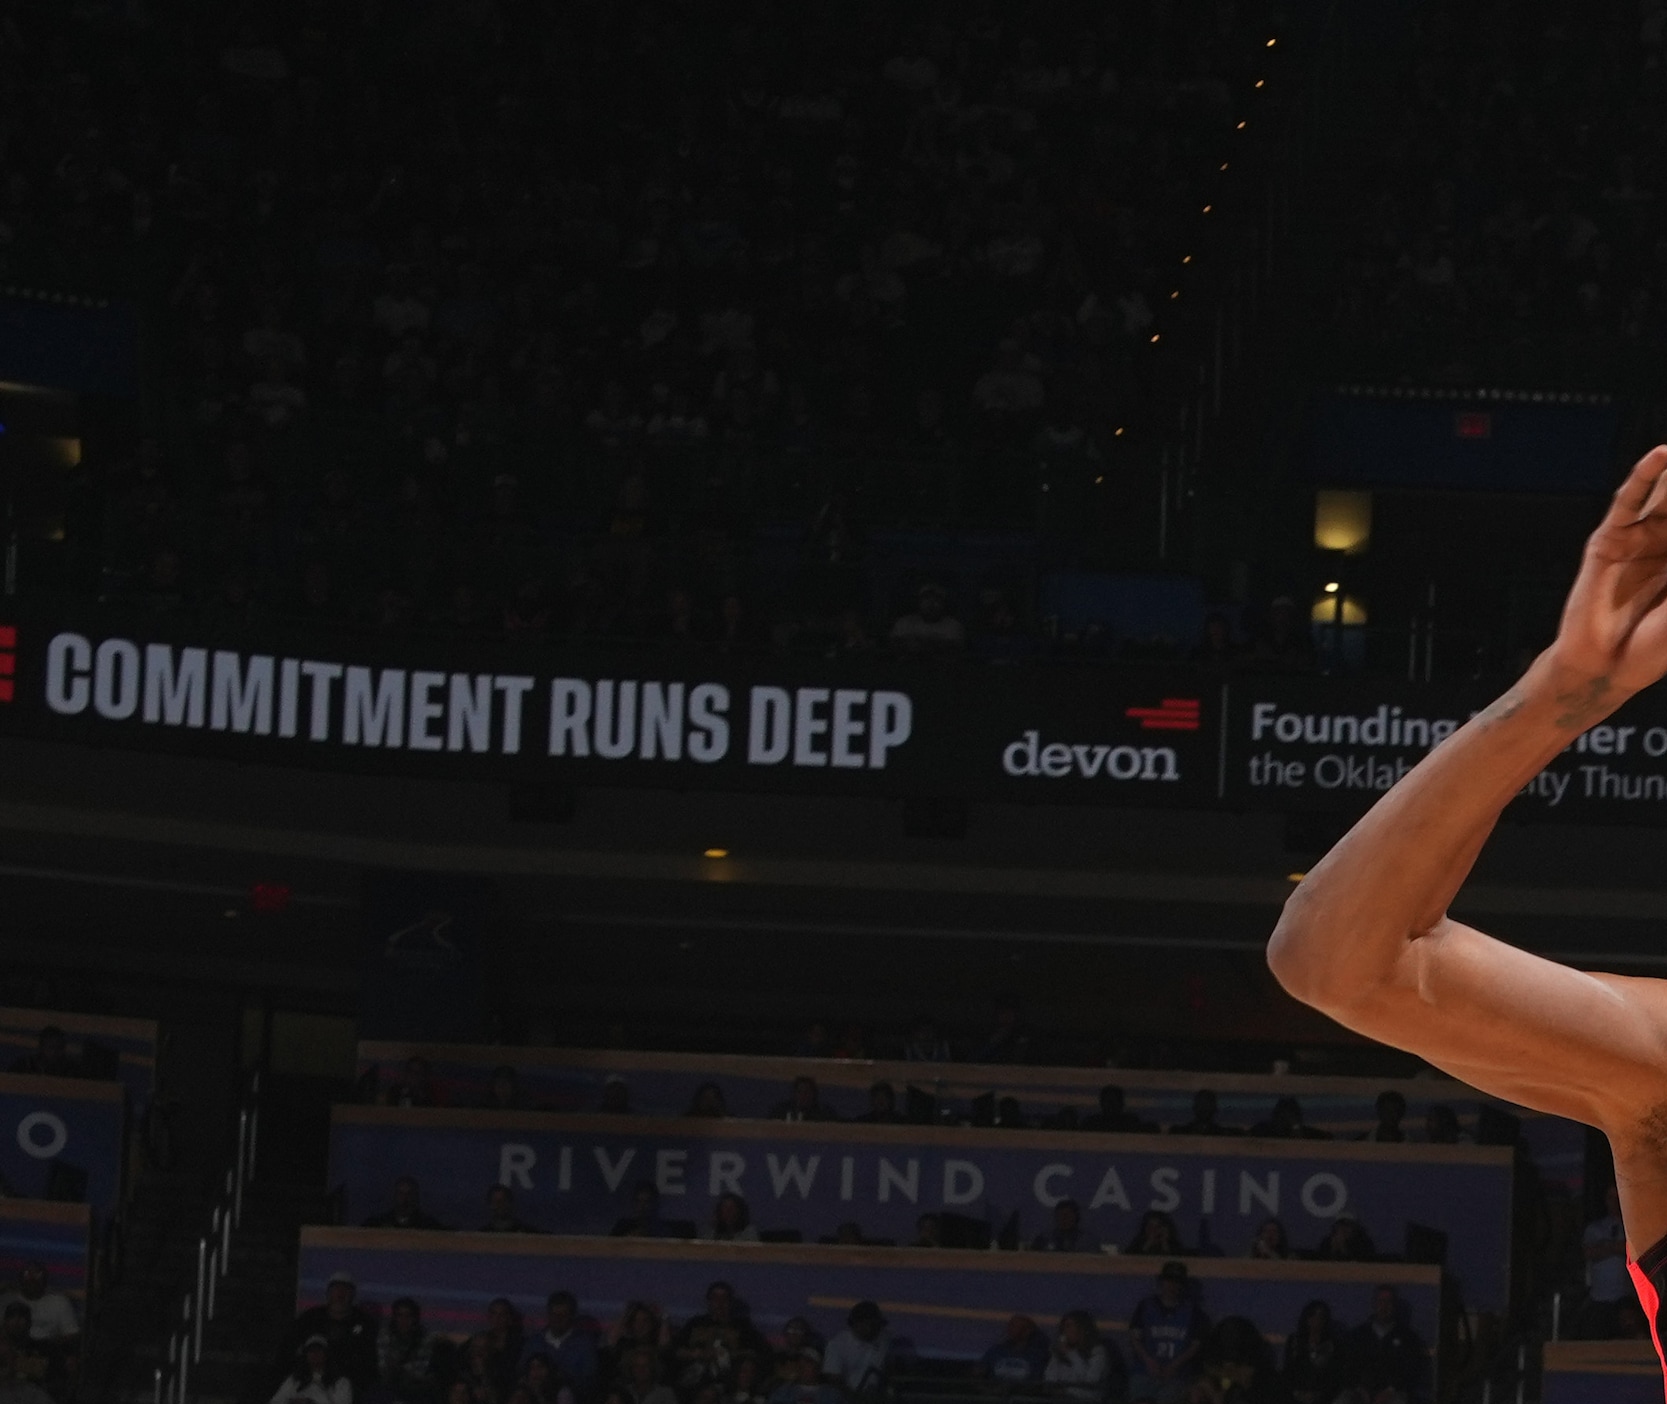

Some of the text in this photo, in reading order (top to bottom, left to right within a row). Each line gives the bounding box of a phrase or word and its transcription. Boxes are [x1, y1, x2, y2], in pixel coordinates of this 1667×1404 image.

[45, 632, 914, 769] COMMITMENT RUNS DEEP
[1002, 730, 1180, 783] devon
[1249, 752, 1305, 788] the
[498, 1144, 1349, 1220] RIVERWIND CASINO
